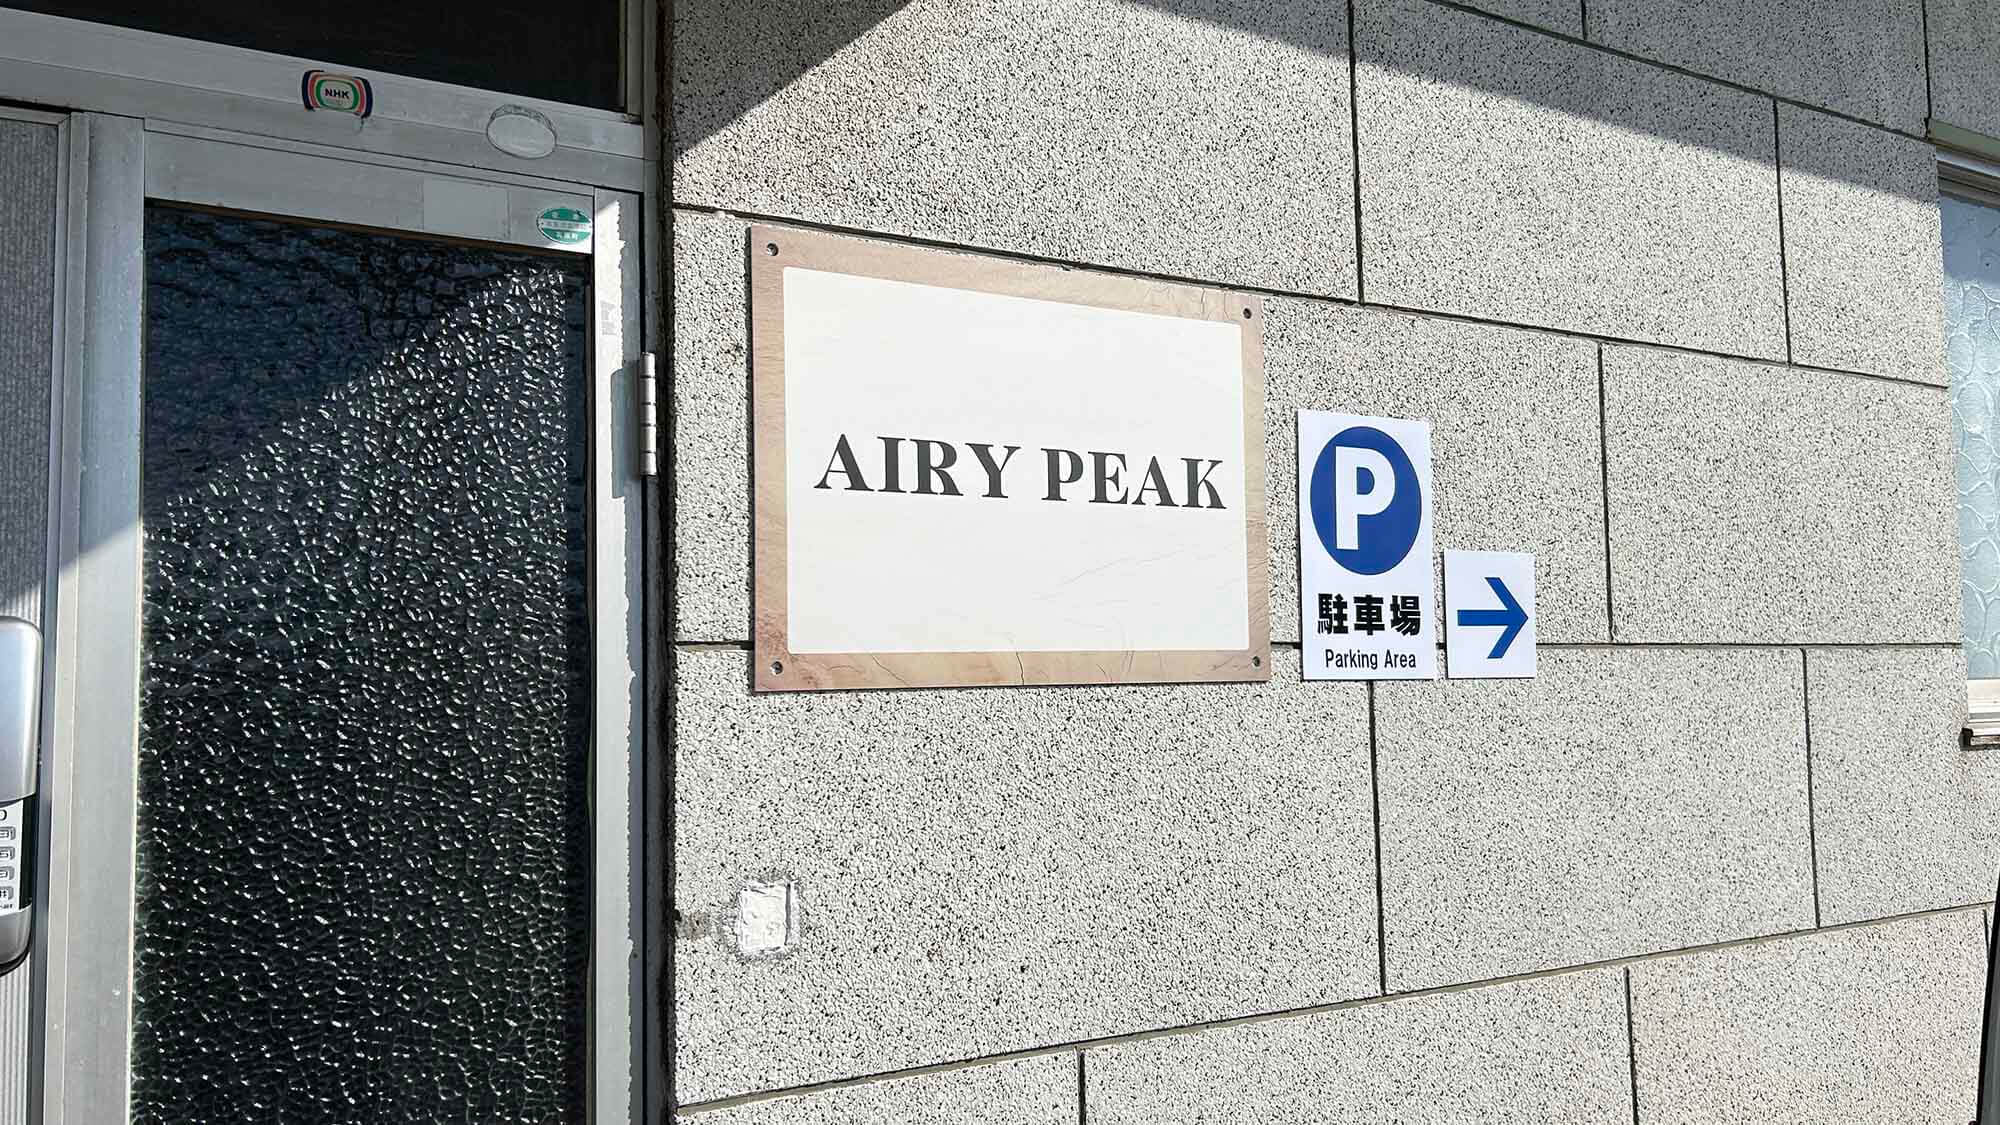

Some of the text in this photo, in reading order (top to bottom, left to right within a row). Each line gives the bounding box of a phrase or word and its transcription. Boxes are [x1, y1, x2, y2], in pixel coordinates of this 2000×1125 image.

[324, 88, 350, 100] NHK
[813, 433, 1227, 510] AIRY PEAK
[1335, 446, 1396, 550] P
[1317, 593, 1421, 636] 駐車場
[1325, 649, 1416, 671] Parking Area
